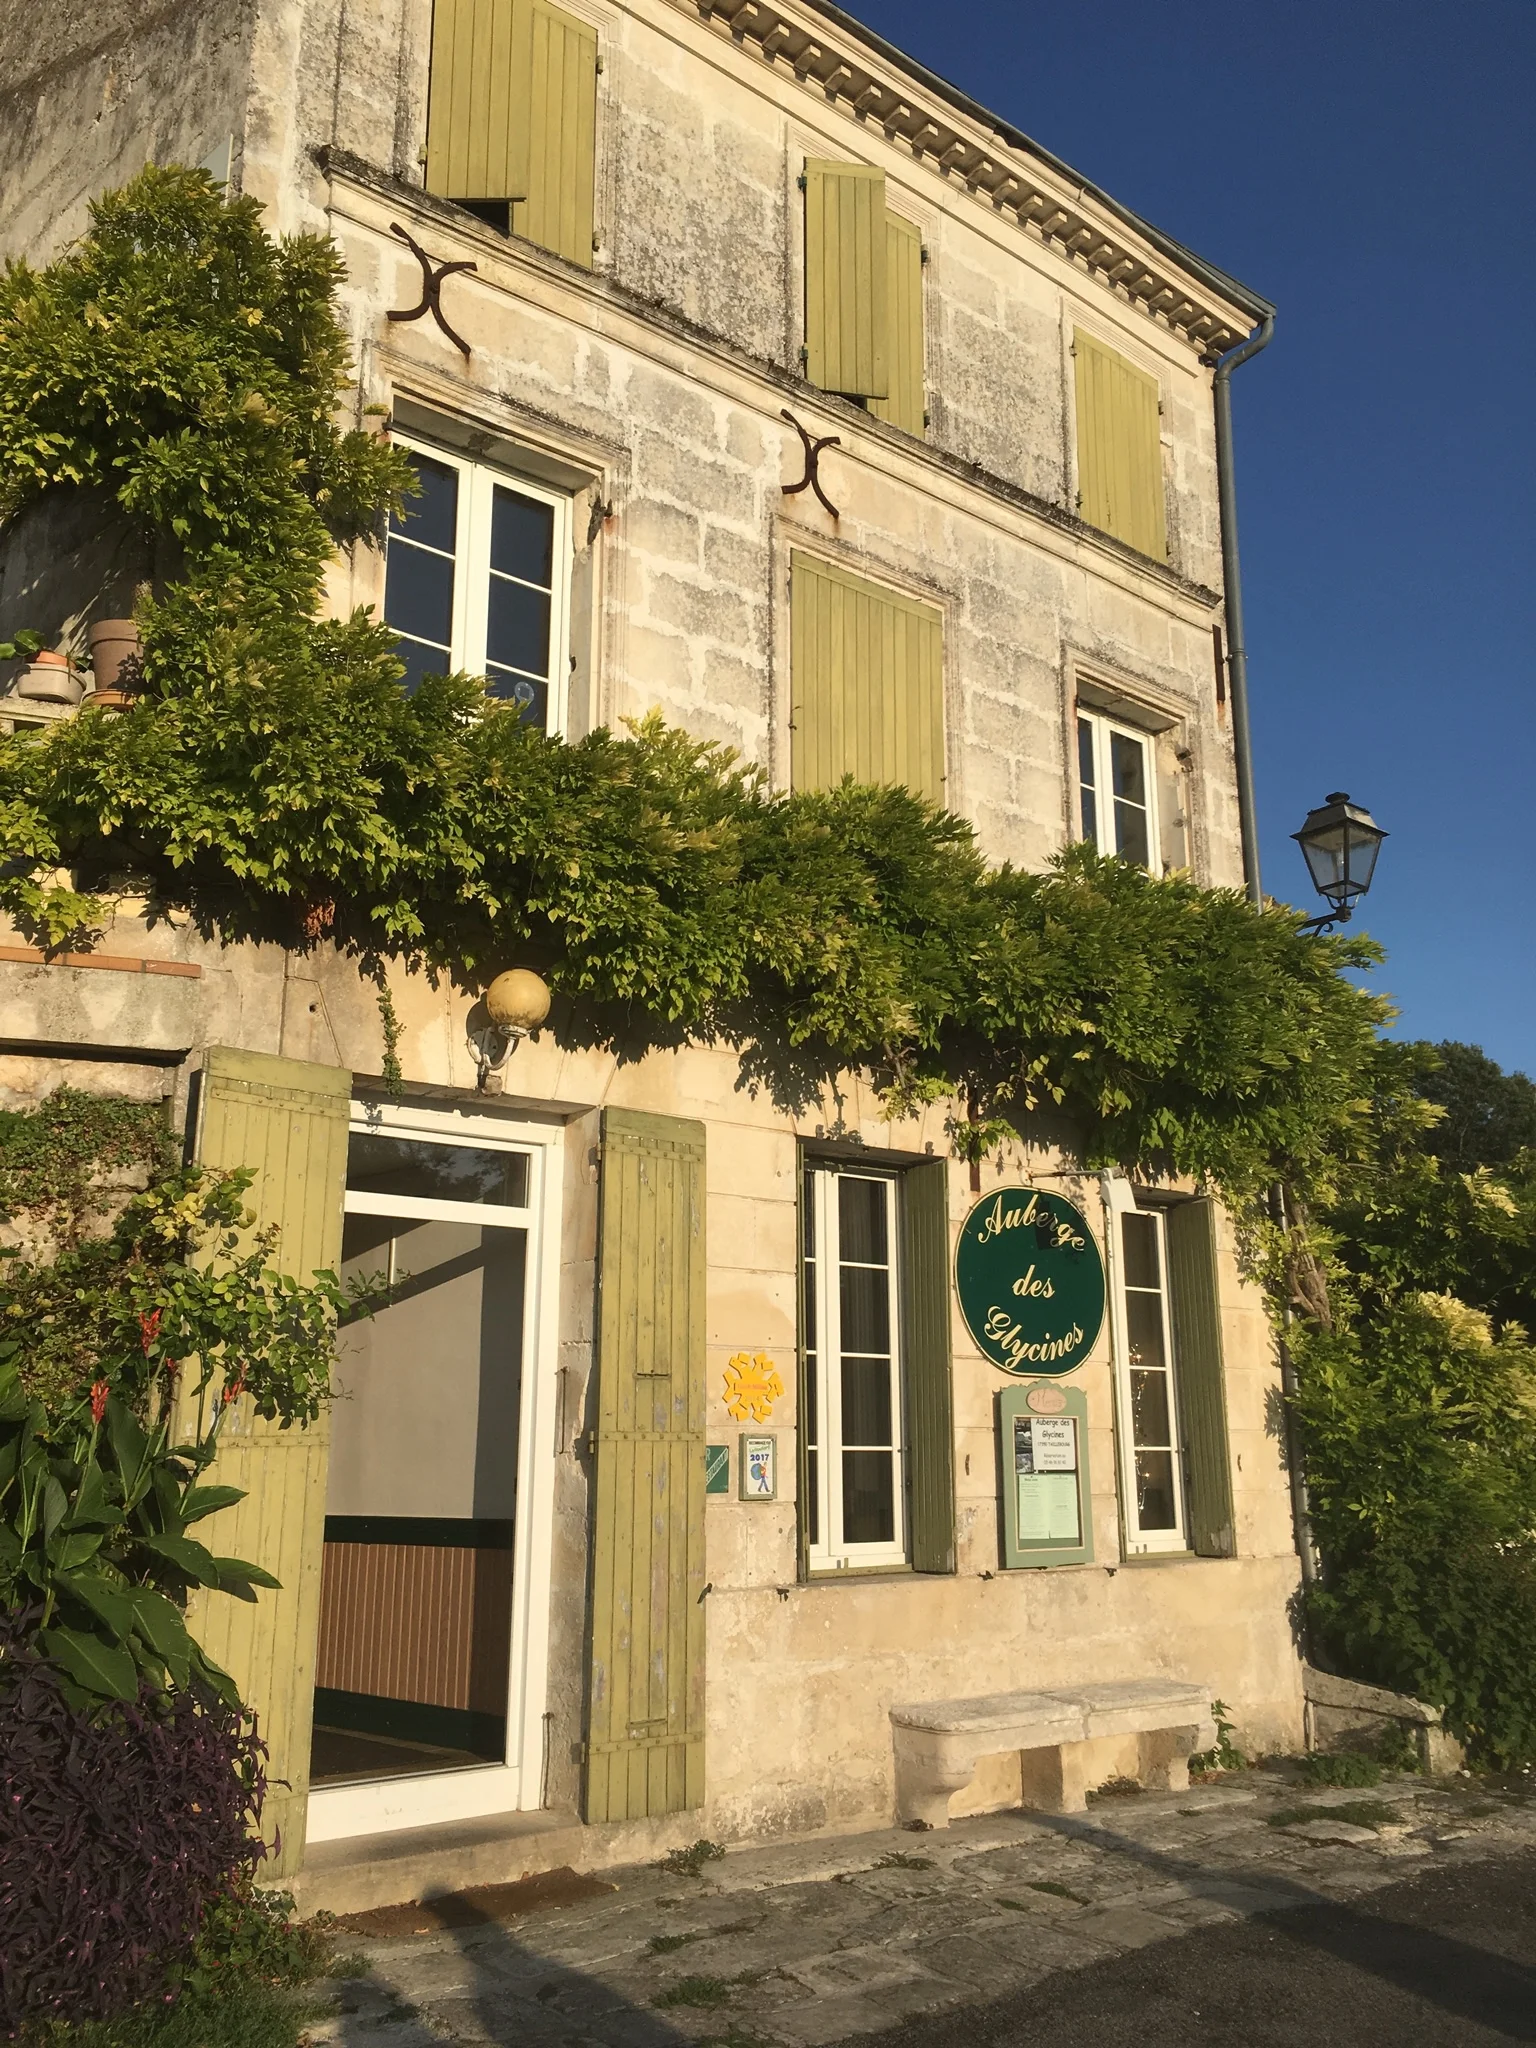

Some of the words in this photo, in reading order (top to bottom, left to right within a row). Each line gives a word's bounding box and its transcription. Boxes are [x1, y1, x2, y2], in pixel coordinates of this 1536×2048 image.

[978, 1194, 1085, 1251] Auberge
[1012, 1264, 1055, 1299] des
[984, 1305, 1084, 1369] Glycines
[1036, 1419, 1059, 1428] Auberge
[1042, 1430, 1065, 1440] Glycines
